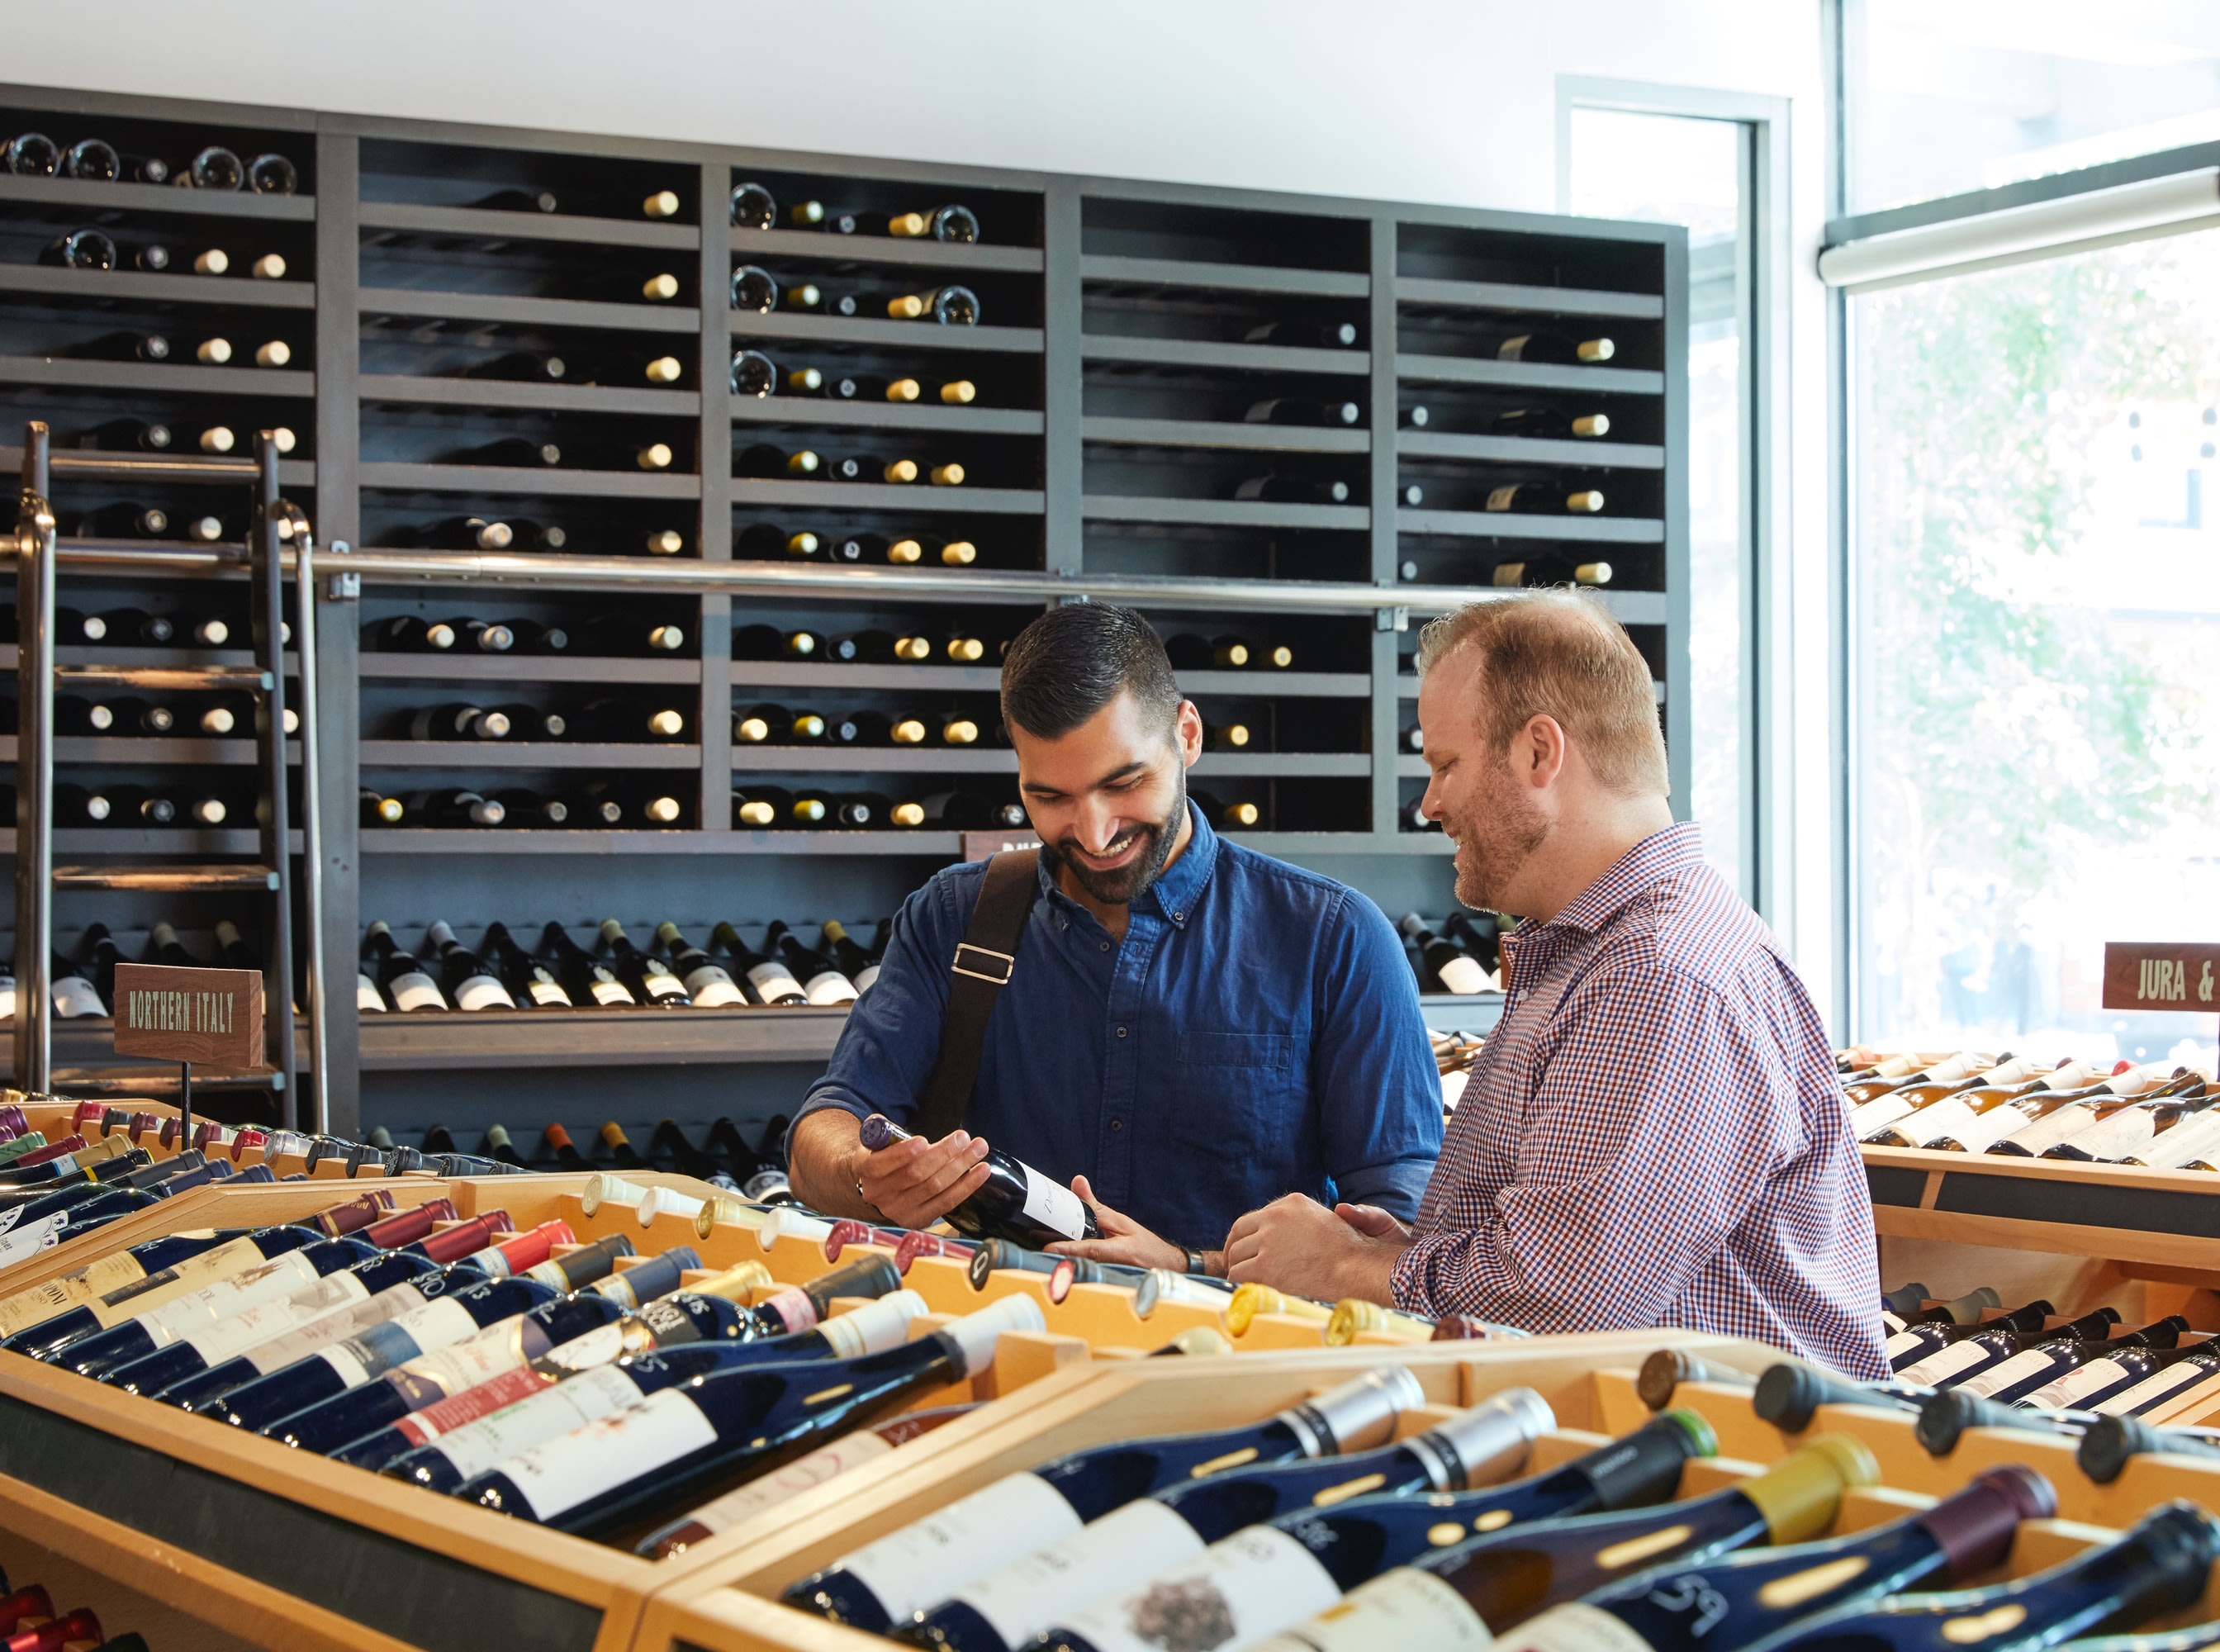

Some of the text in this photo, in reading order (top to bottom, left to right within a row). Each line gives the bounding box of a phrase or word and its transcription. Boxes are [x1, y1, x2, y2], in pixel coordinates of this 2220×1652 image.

[2137, 959, 2214, 1002] JURA &
[130, 990, 234, 1033] NORTHERN ITALY
